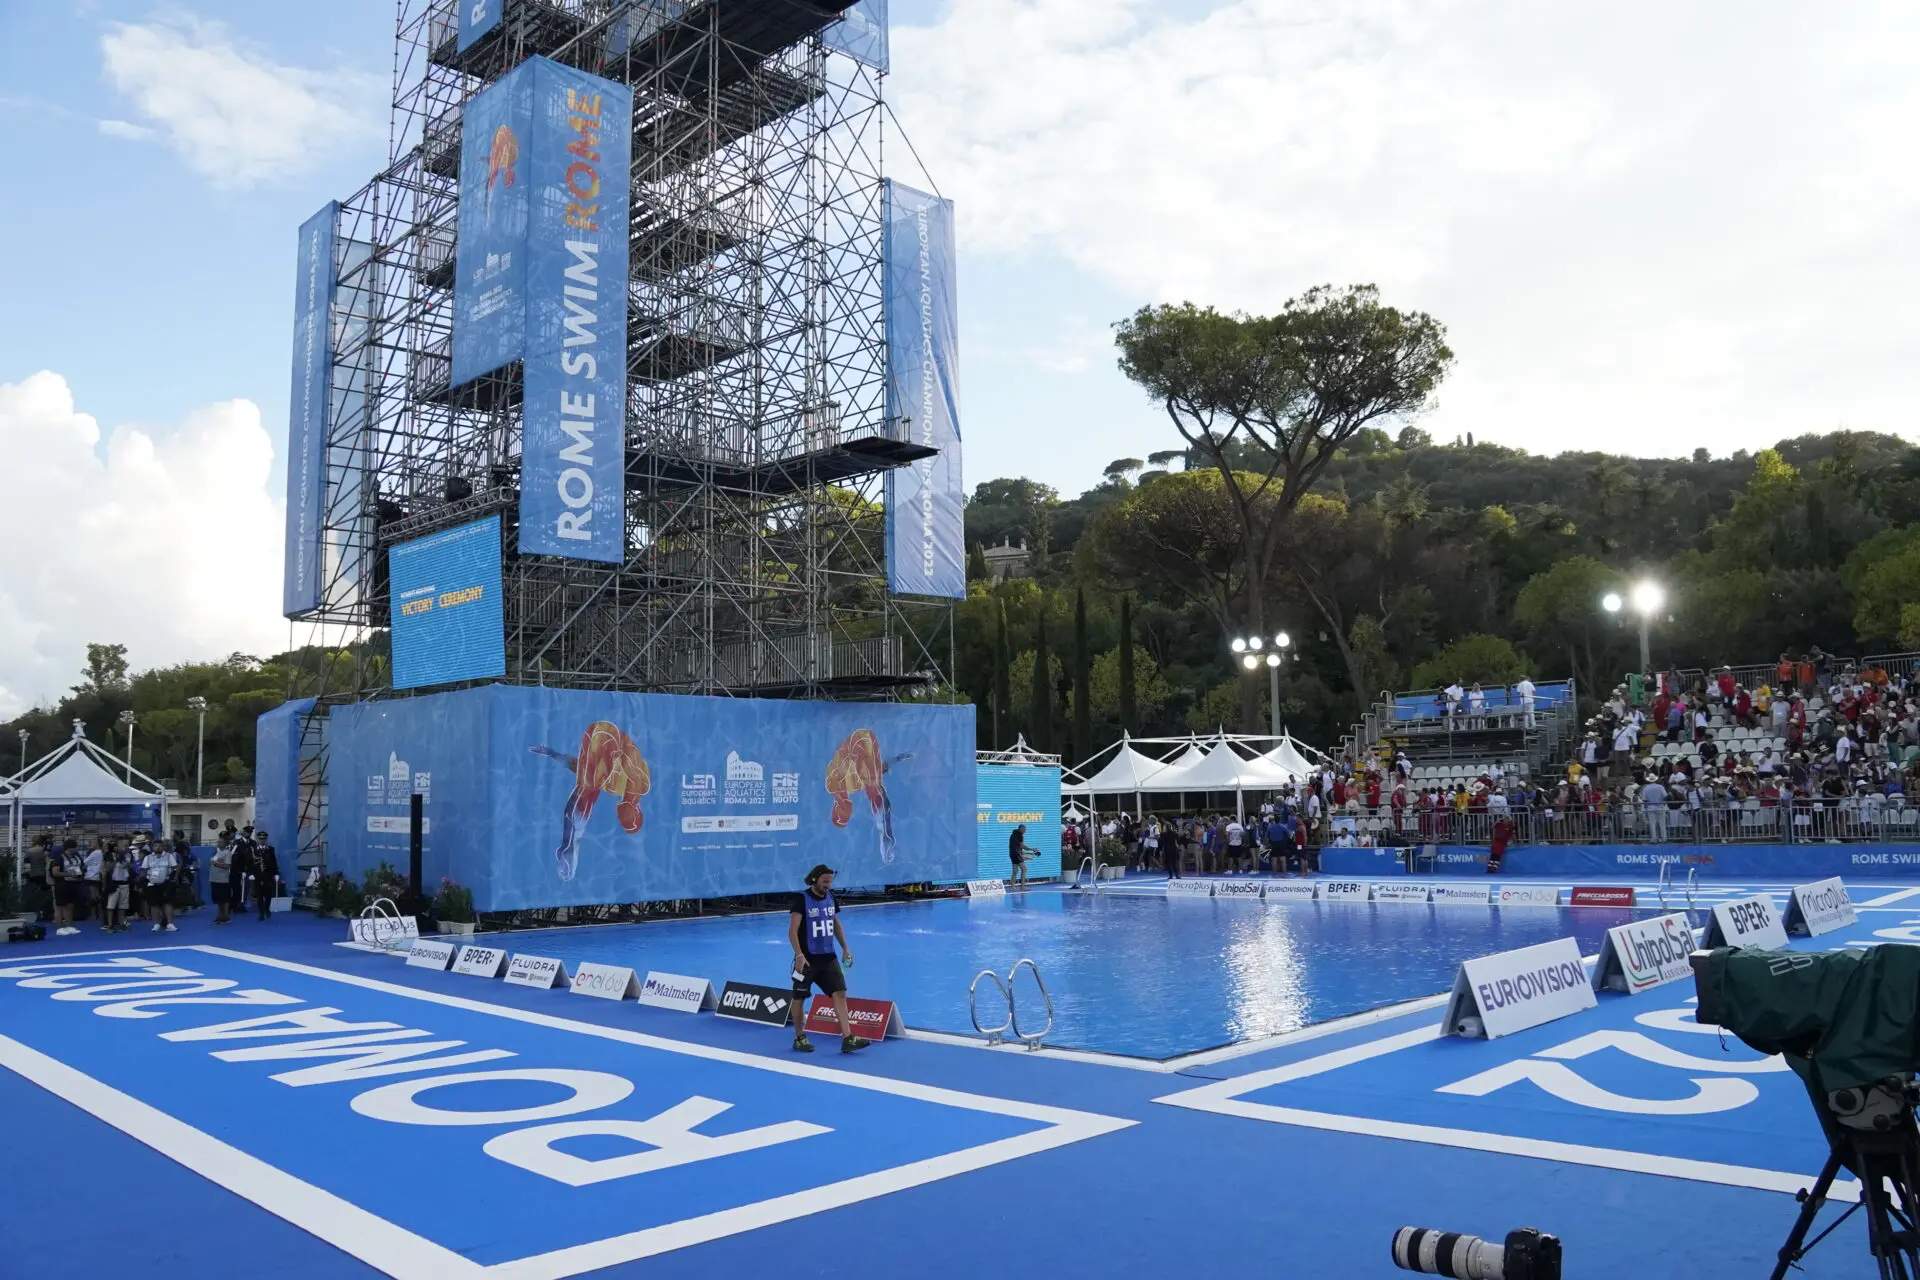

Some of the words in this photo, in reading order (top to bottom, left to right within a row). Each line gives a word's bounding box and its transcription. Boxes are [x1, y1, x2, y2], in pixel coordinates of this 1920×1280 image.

[564, 88, 602, 232] ROME
[917, 204, 931, 280] EUROPEAN
[561, 240, 599, 379] SWIM
[920, 284, 933, 356] AQUATICS
[922, 360, 934, 485] CHAMPIONHIPS
[300, 434, 308, 508] AQUATICS
[557, 391, 595, 541] ROME
[922, 489, 933, 538] ROMA
[923, 541, 934, 577] 2022
[402, 597, 434, 616] VICTORY
[438, 585, 484, 608] CEREMONY
[681, 790, 716, 798] european
[681, 797, 717, 805] aquatics
[724, 788, 766, 797] AQUATICS
[996, 811, 1044, 823] CEREMONY
[1447, 854, 1474, 863] SWIM
[1616, 854, 1649, 864] ROME
[1650, 854, 1681, 864] SWIM
[1852, 853, 1889, 864] ROME
[971, 880, 1003, 894] UnipolSai
[1220, 882, 1260, 896] UnipolSai
[1378, 885, 1426, 893] FLUIDRA
[1446, 889, 1487, 899] Malmsten
[1619, 919, 1697, 980] UnipolSai
[511, 958, 555, 973] FLUIDRA
[0, 957, 307, 1019] 2022
[576, 972, 604, 990] enel
[654, 983, 701, 1003] Malmsten
[723, 990, 760, 1011] arena
[815, 1006, 884, 1023] FREAROSSA
[156, 1006, 836, 1188] ROMA
